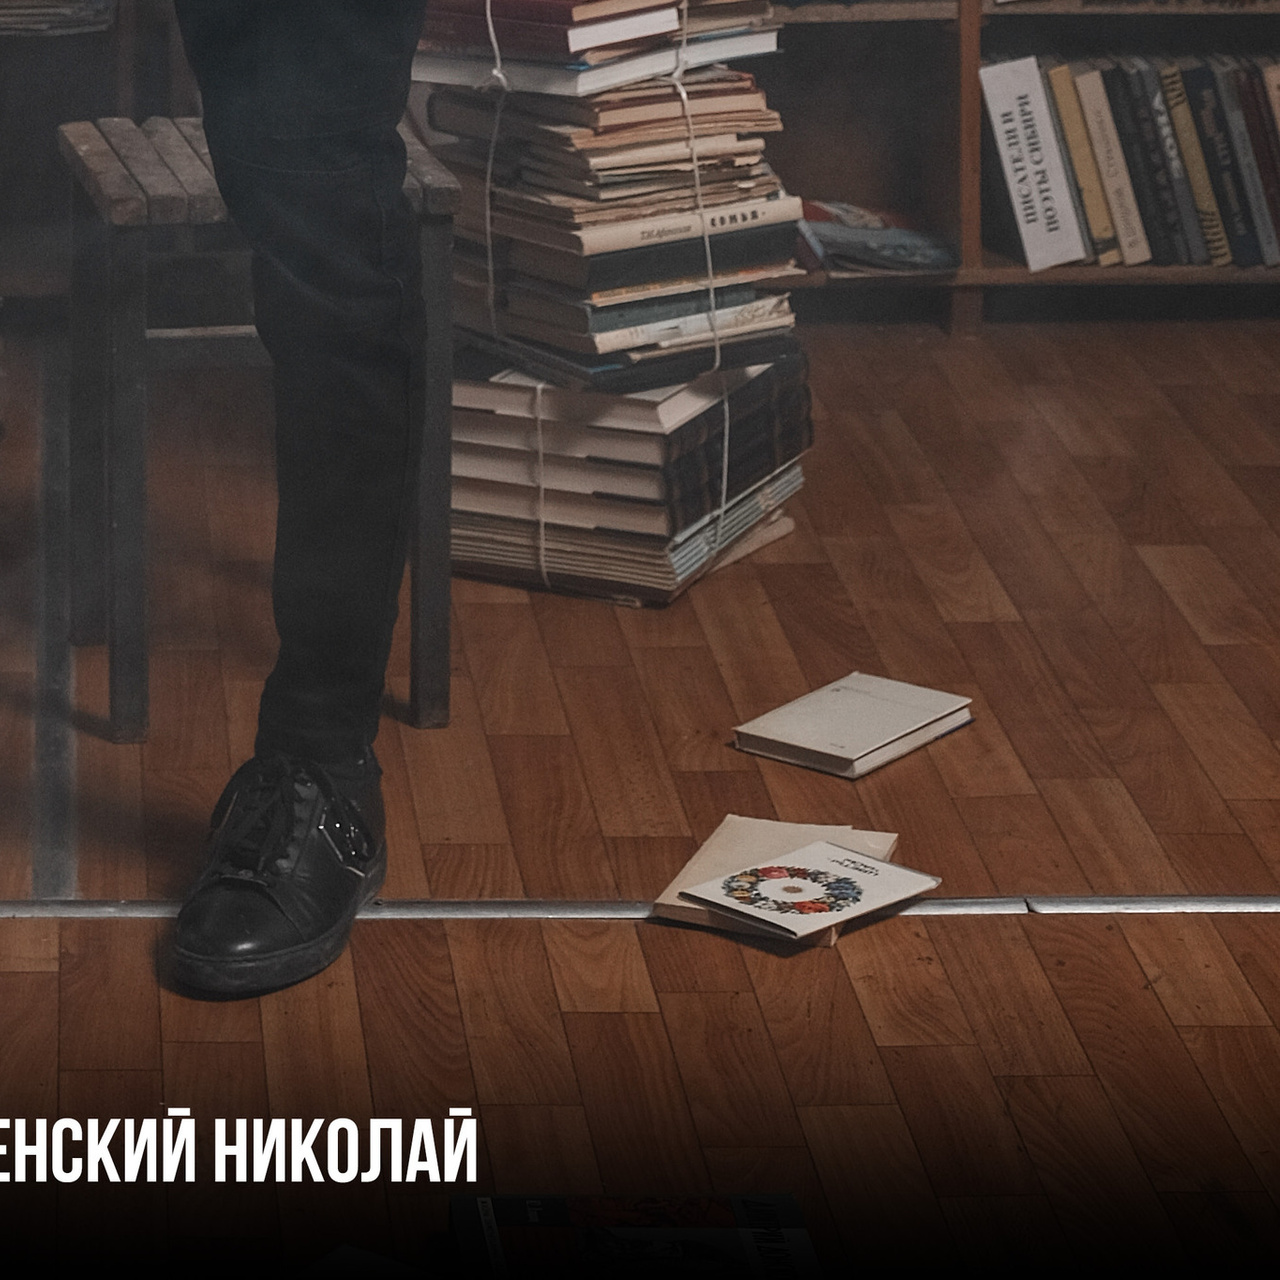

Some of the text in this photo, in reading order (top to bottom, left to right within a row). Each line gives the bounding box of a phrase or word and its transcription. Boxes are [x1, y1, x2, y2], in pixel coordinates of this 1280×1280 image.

[1000, 109, 1038, 226] ПИСАТЕЛИ И
[1014, 93, 1062, 235] ПОЭТЫ СИБИРИ
